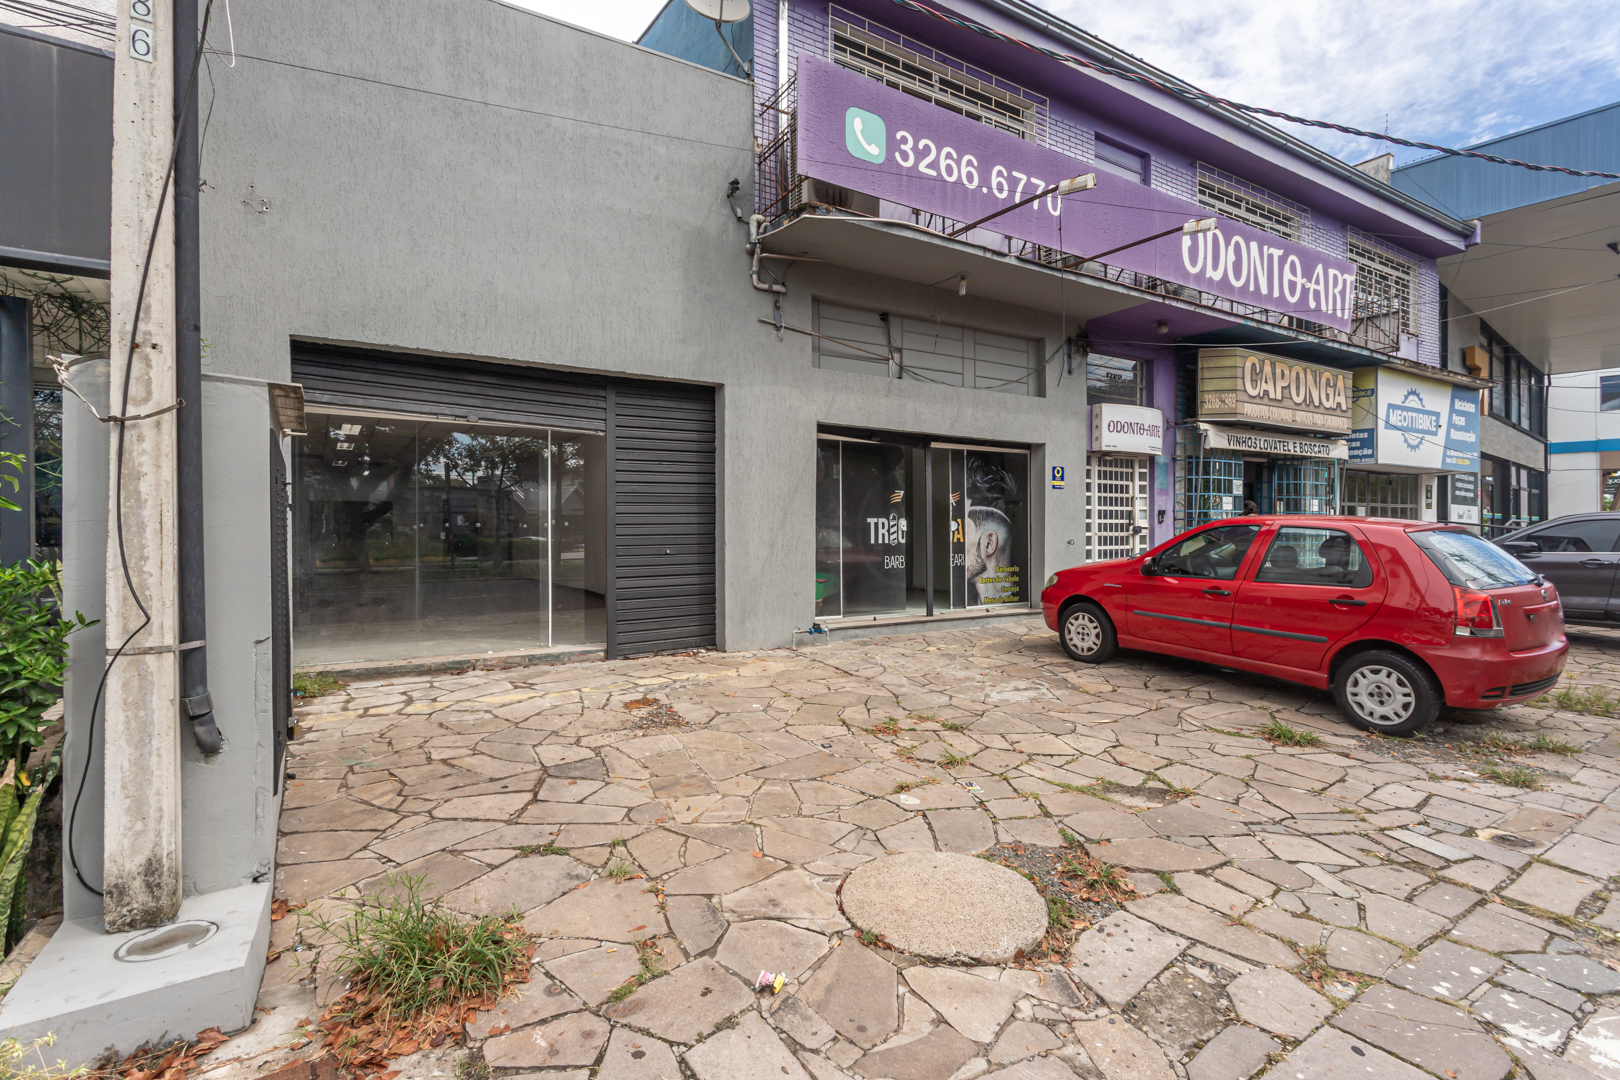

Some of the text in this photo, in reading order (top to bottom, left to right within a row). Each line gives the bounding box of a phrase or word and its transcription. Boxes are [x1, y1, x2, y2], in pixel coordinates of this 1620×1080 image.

[895, 130, 1062, 216] 3266.6770
[1244, 356, 1347, 411] CAPONGA
[1226, 434, 1330, 456] VINHOS LOVATEL E BOSCATO
[995, 565, 1020, 573] Barbearia
[979, 576, 995, 584] Cortes
[996, 575, 1002, 583] de
[1001, 585, 1020, 593] Cerveja
